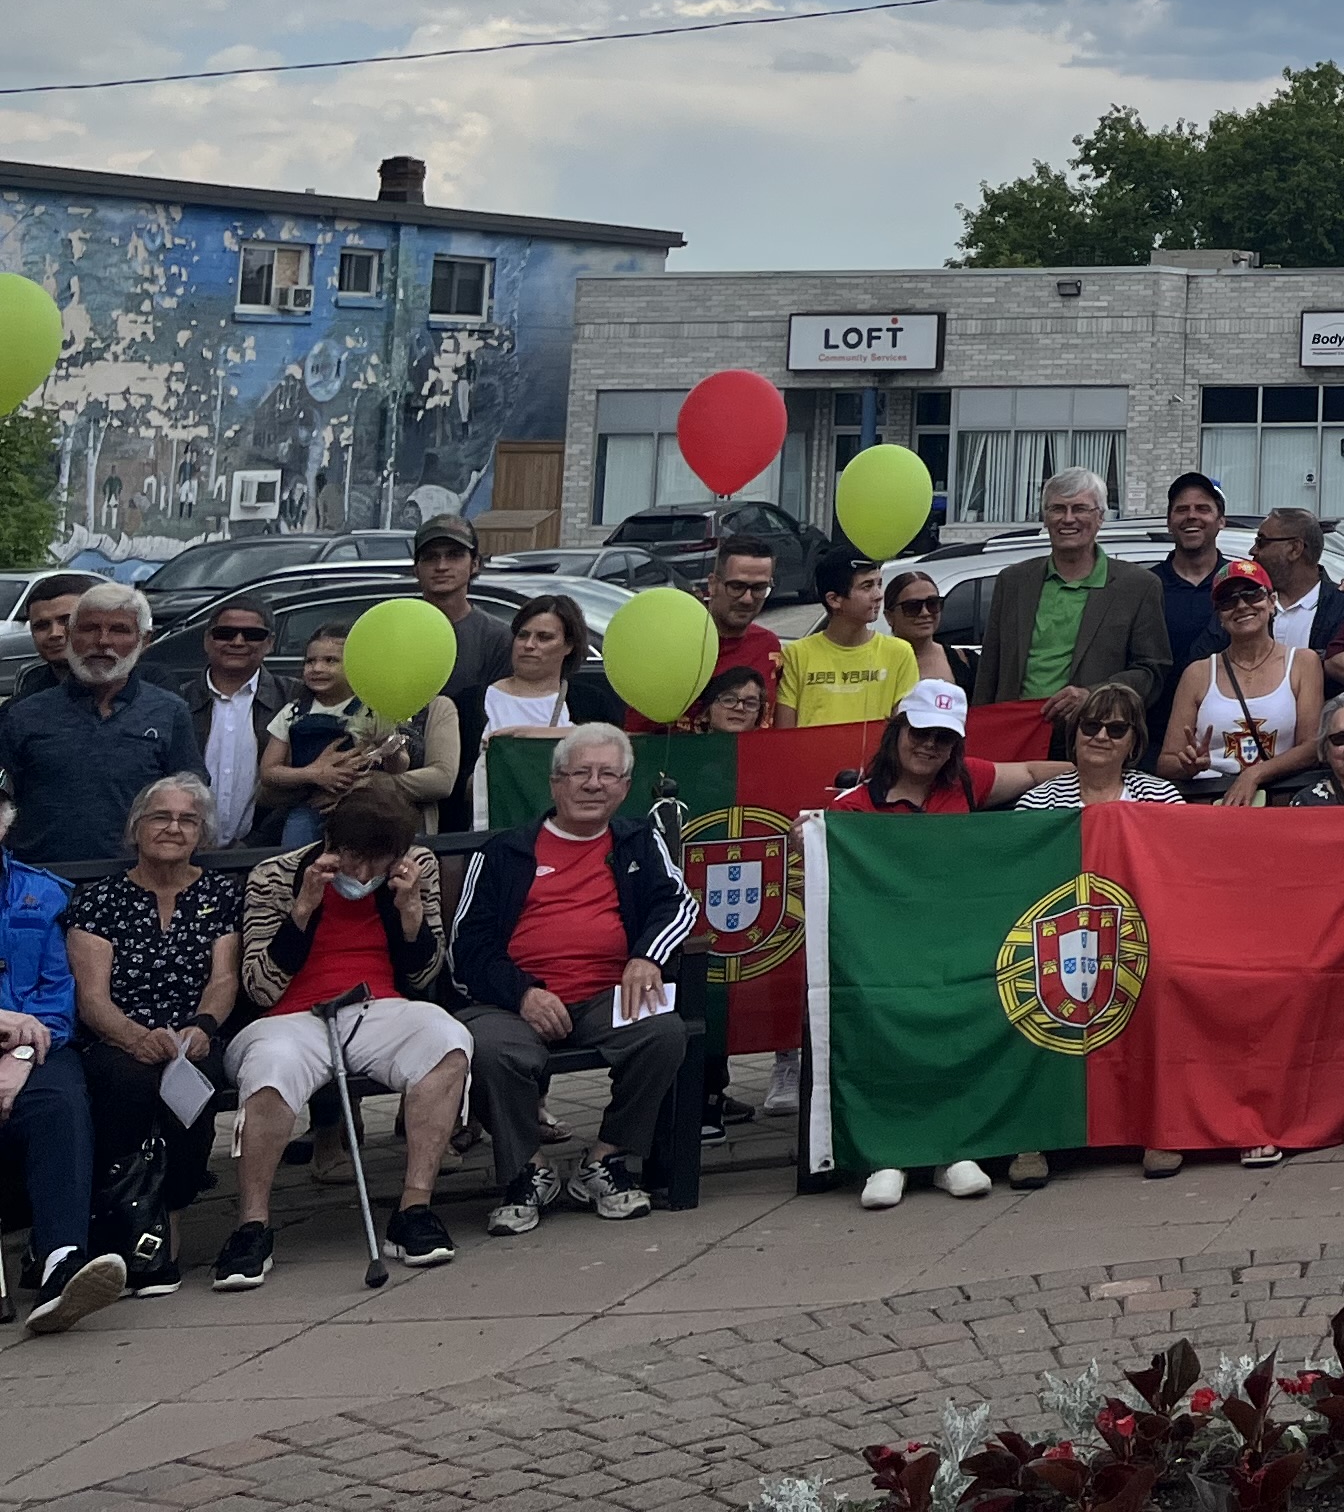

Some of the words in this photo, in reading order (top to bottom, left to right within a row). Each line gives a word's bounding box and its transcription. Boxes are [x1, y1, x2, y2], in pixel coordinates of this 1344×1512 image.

[824, 327, 904, 350] LOFT
[818, 353, 868, 363] Community
[870, 353, 908, 362] Services
